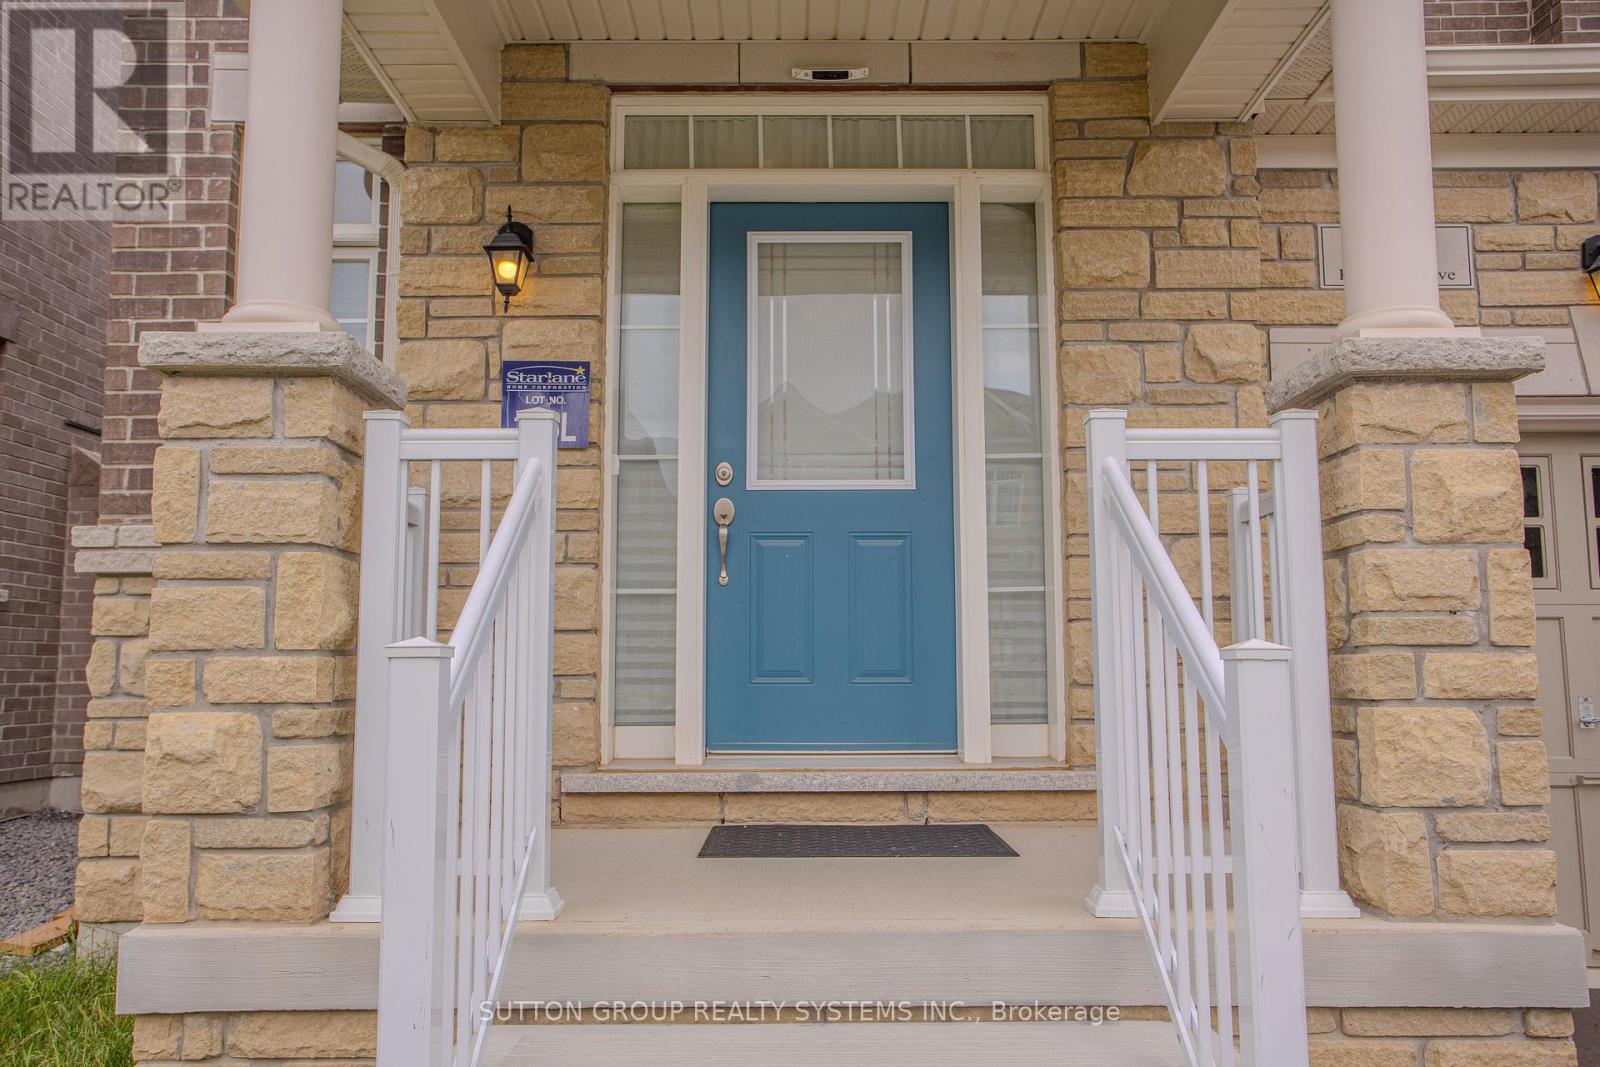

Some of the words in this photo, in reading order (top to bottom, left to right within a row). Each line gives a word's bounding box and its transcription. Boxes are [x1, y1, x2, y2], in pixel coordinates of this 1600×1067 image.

[506, 371, 587, 384] Starlane
[525, 396, 545, 405] LOT
[549, 396, 567, 405] NO.
[561, 412, 577, 442] L
